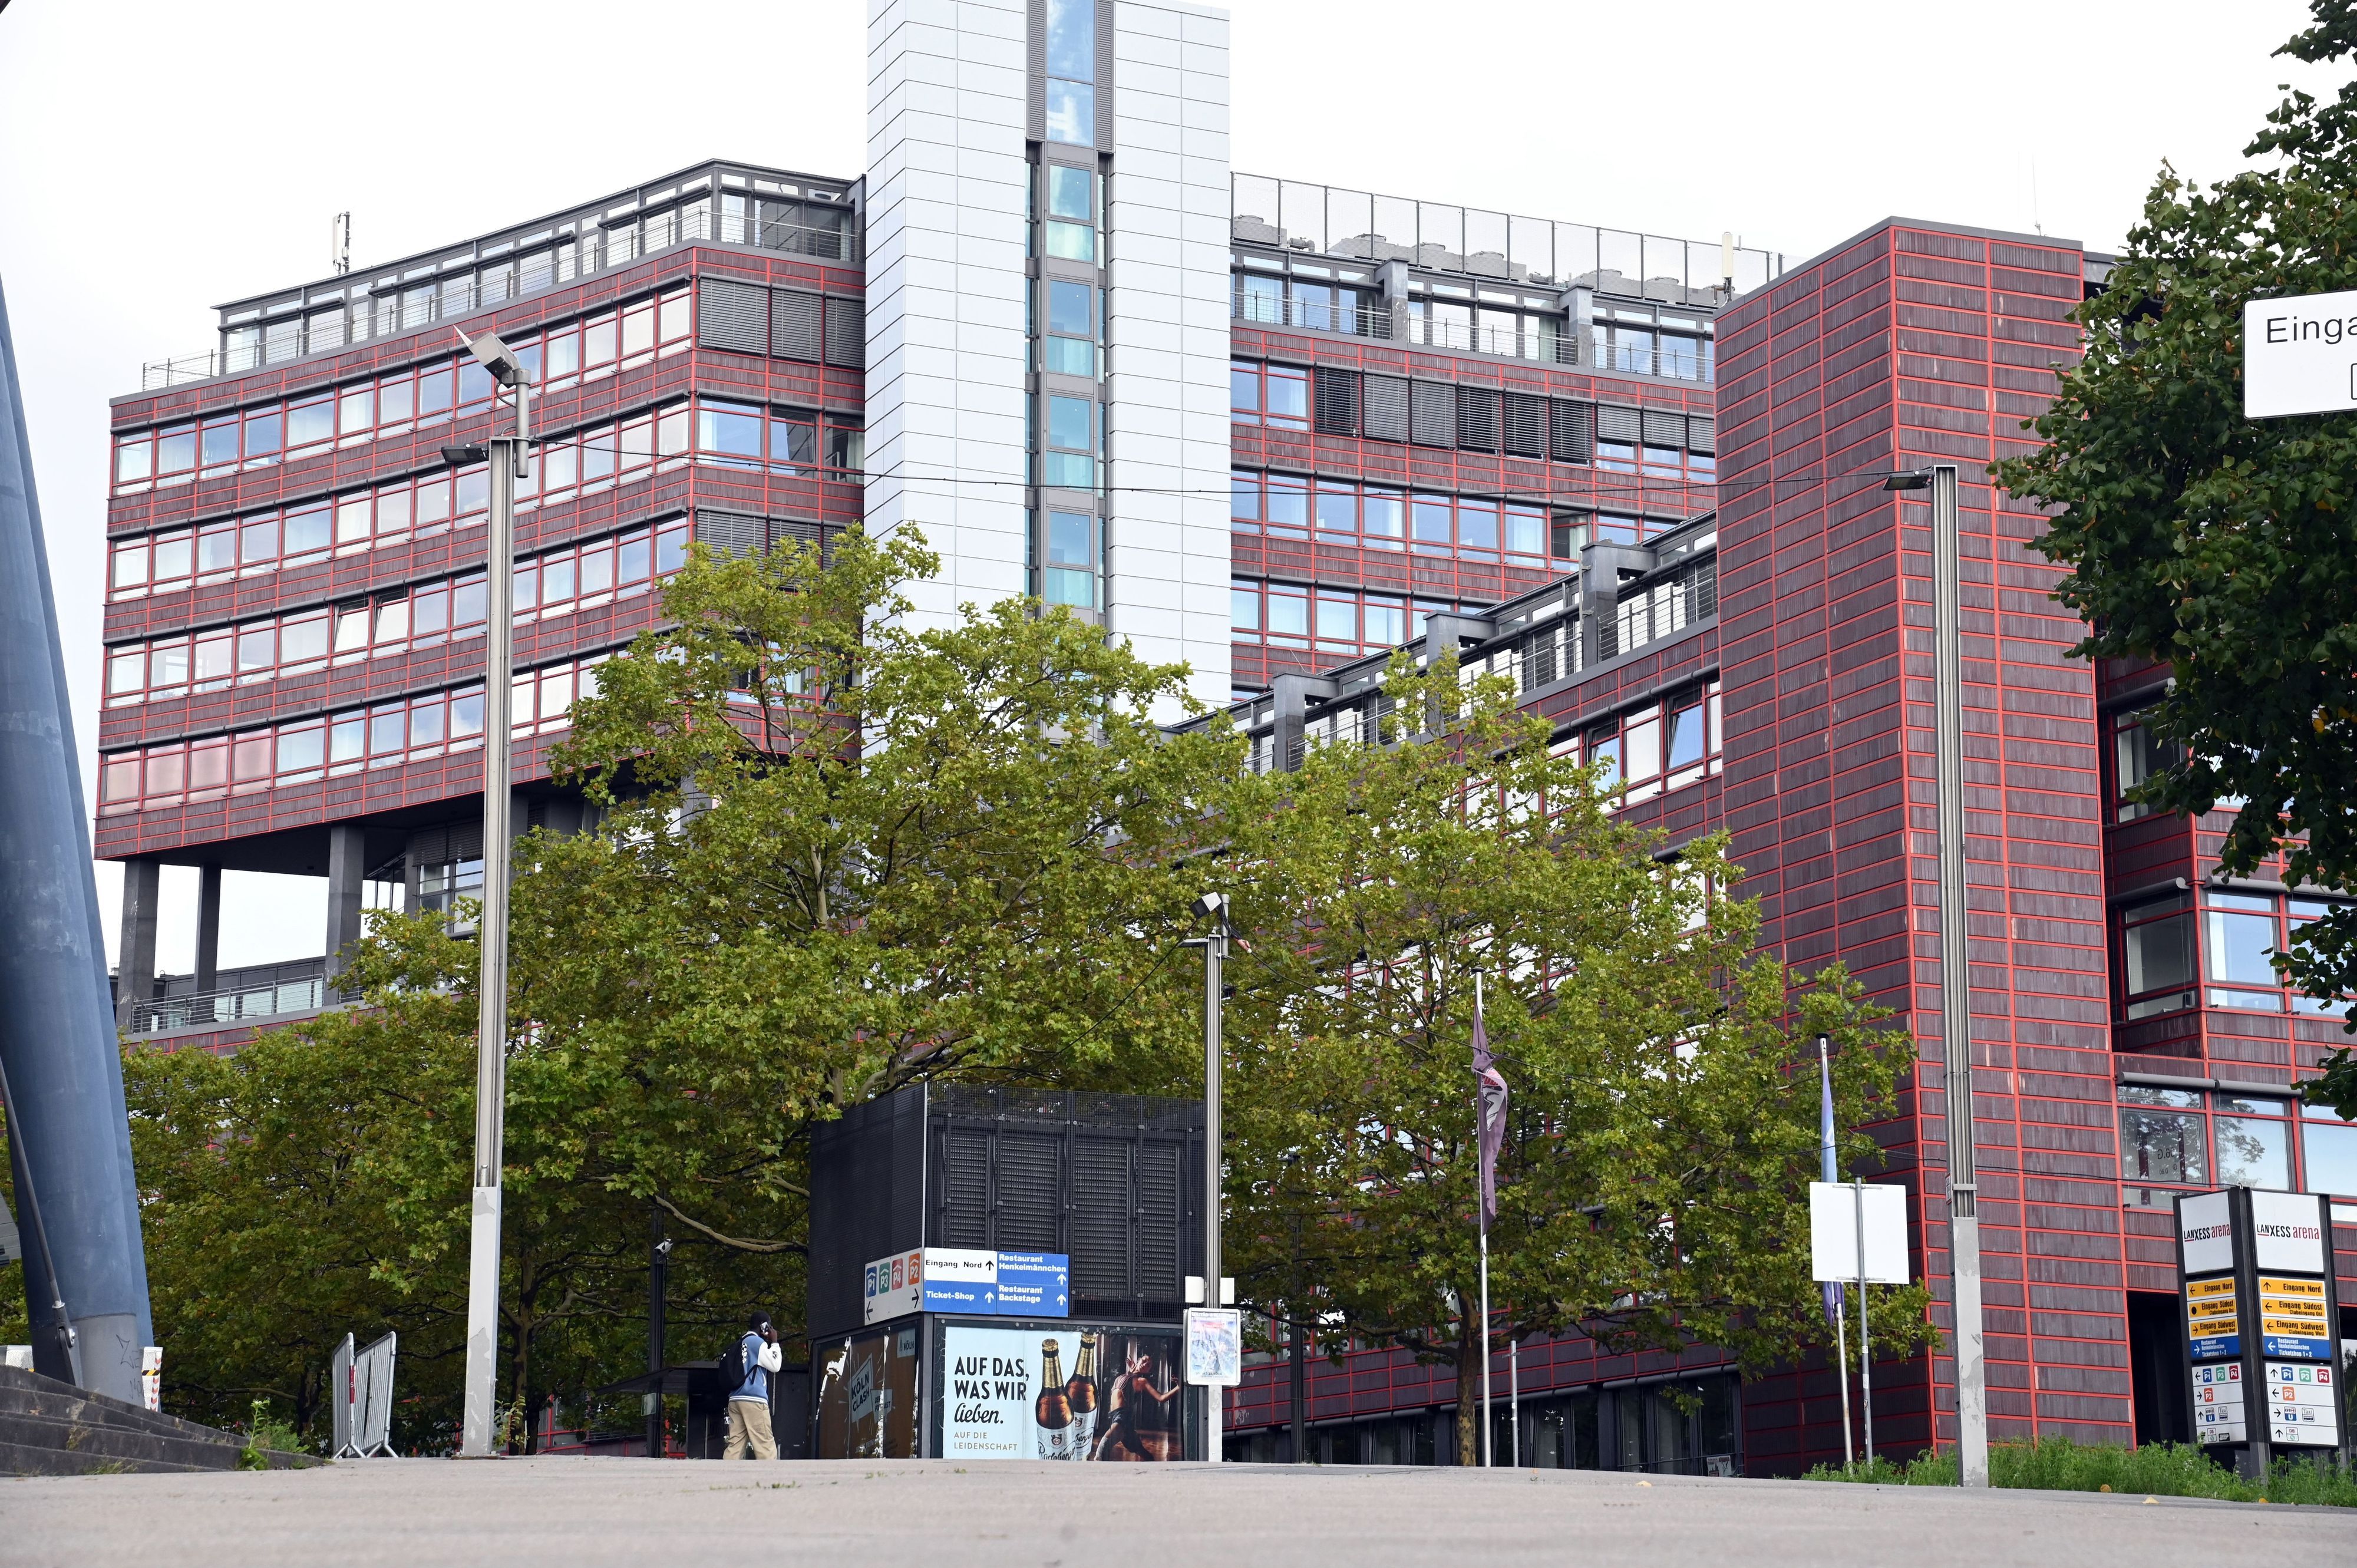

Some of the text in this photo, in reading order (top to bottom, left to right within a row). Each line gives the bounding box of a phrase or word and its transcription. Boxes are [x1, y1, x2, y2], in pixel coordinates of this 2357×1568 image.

[2184, 1224, 2230, 1241] LANXESS arena
[2257, 1224, 2319, 1240] LANXESS arena
[999, 1254, 1043, 1263] Restaurant
[926, 1260, 958, 1269] Eingang
[999, 1263, 1067, 1272] Henkelmännchen
[868, 1265, 918, 1292] P1 P3 P4 P2
[999, 1285, 1043, 1294] Restaurant
[2283, 1283, 2305, 1292] Eingang
[926, 1290, 975, 1301] Ticket-Shop
[999, 1293, 1041, 1303] Backstage
[2219, 1300, 2234, 1308] Südost
[2279, 1301, 2322, 1310] Eingang Südost
[2217, 1321, 2236, 1329] Südwest
[2276, 1321, 2324, 1331] Eingang Südwest
[903, 1341, 914, 1351] KÖLN
[954, 1356, 1029, 1381] AUF DAS,
[851, 1371, 869, 1400] KÖLN
[954, 1379, 1026, 1401] WAS WIR
[853, 1386, 870, 1412] CLASH
[954, 1402, 1003, 1424] lieben.
[954, 1442, 1018, 1451] LEIDENSCHAFT
